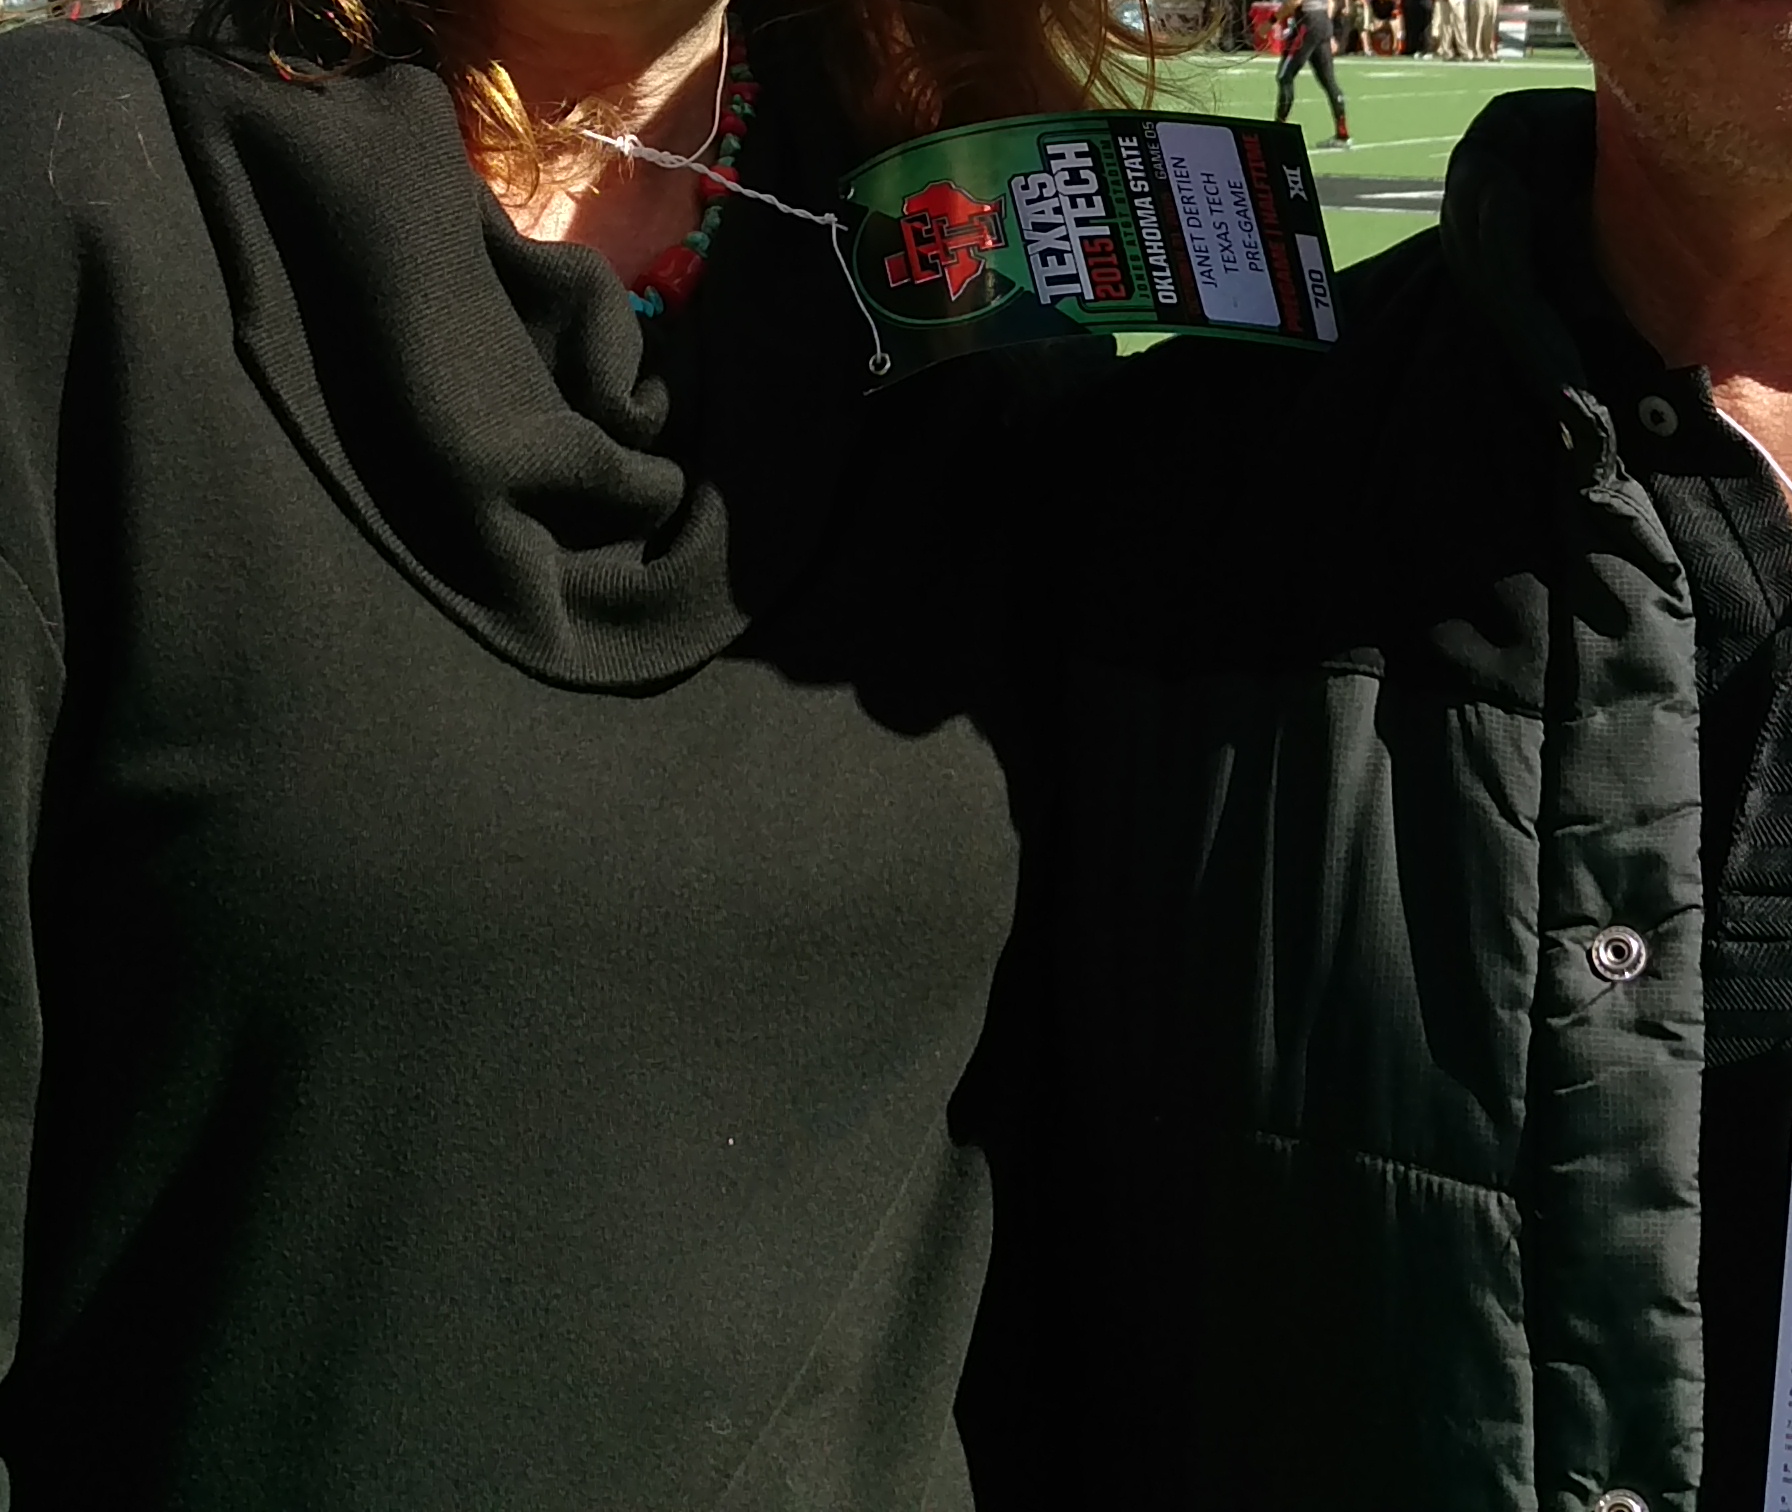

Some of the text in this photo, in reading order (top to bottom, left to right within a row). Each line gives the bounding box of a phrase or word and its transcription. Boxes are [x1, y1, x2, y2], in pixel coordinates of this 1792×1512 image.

[1046, 142, 1111, 240] TECH
[1149, 143, 1167, 180] GAME
[1242, 133, 1279, 230] HALFTIME
[1011, 172, 1082, 305] TEXAS
[1118, 136, 1177, 304] OKLAHOMA STATE
[1171, 156, 1217, 288] JANET DERTIEN
[1201, 173, 1239, 274] TEXAS TECH
[1229, 180, 1264, 273] PRE-GAME
[1083, 238, 1127, 300] 2015
[1309, 270, 1330, 309] 700
